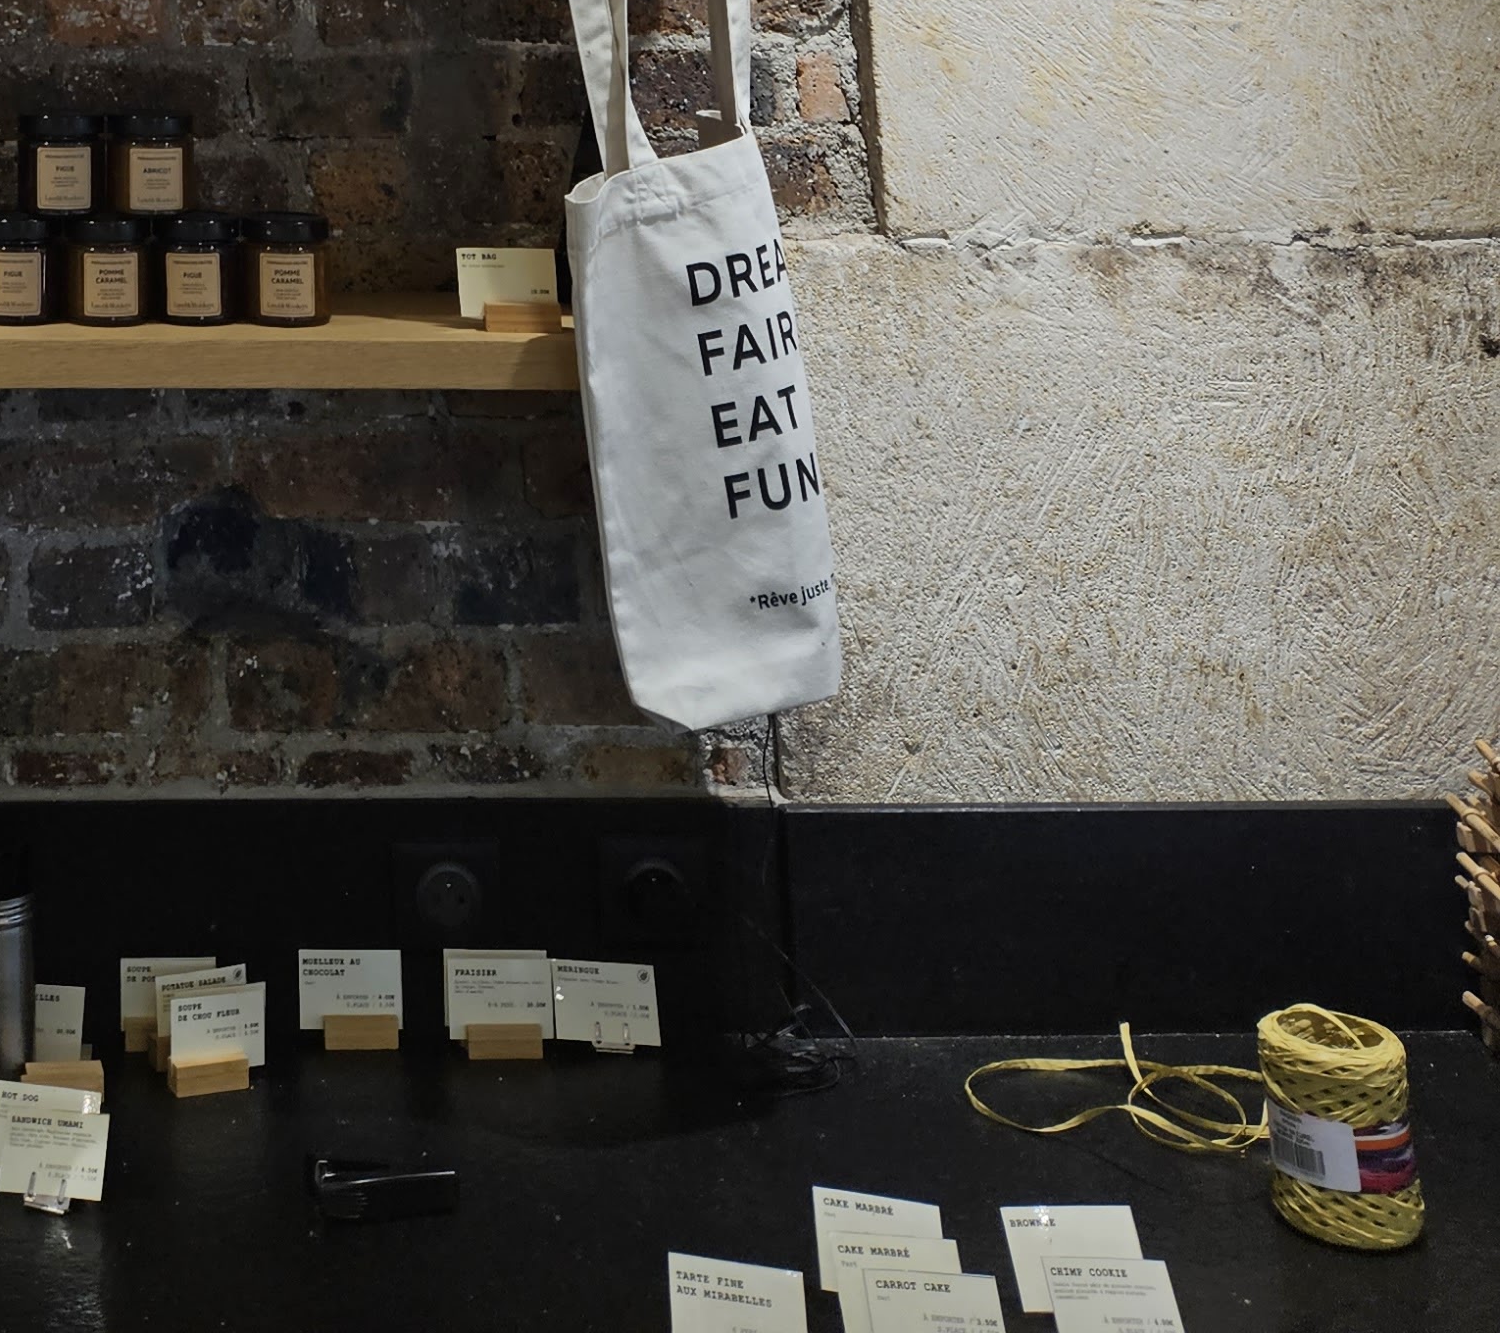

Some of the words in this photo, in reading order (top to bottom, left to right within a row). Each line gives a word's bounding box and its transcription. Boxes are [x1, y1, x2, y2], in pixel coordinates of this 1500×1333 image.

[481, 253, 497, 261] BAG
[710, 384, 798, 449] EAT
[723, 452, 820, 520] FUN
[302, 957, 345, 966] MOELLEUX
[349, 958, 361, 966] AU
[126, 965, 152, 974] SOUPE
[302, 968, 346, 977] CHOCOLAT
[454, 968, 497, 977] FRAISIER
[556, 965, 600, 975] MERINGUE
[177, 1002, 202, 1013] SOUPE
[177, 1014, 188, 1022] DE
[191, 1011, 213, 1021] CHOU
[216, 1008, 240, 1018] FLEUR
[1, 1090, 19, 1101] HOT
[21, 1093, 39, 1103] DOG
[11, 1115, 53, 1126] SANDWICH
[57, 1119, 84, 1129] UMAMI
[822, 1197, 850, 1209] CAKE
[854, 1201, 894, 1216] MARBRÉ
[837, 1244, 864, 1255] CAKE
[869, 1247, 911, 1259] MARBRÉ
[1088, 1267, 1128, 1278] COOKIE
[675, 1270, 710, 1289] TARTE
[716, 1276, 744, 1290] FINE
[875, 1279, 917, 1291] CARROT
[923, 1282, 951, 1294] CAKE
[676, 1284, 697, 1297] AUX
[703, 1285, 772, 1308] MIRABELLES
